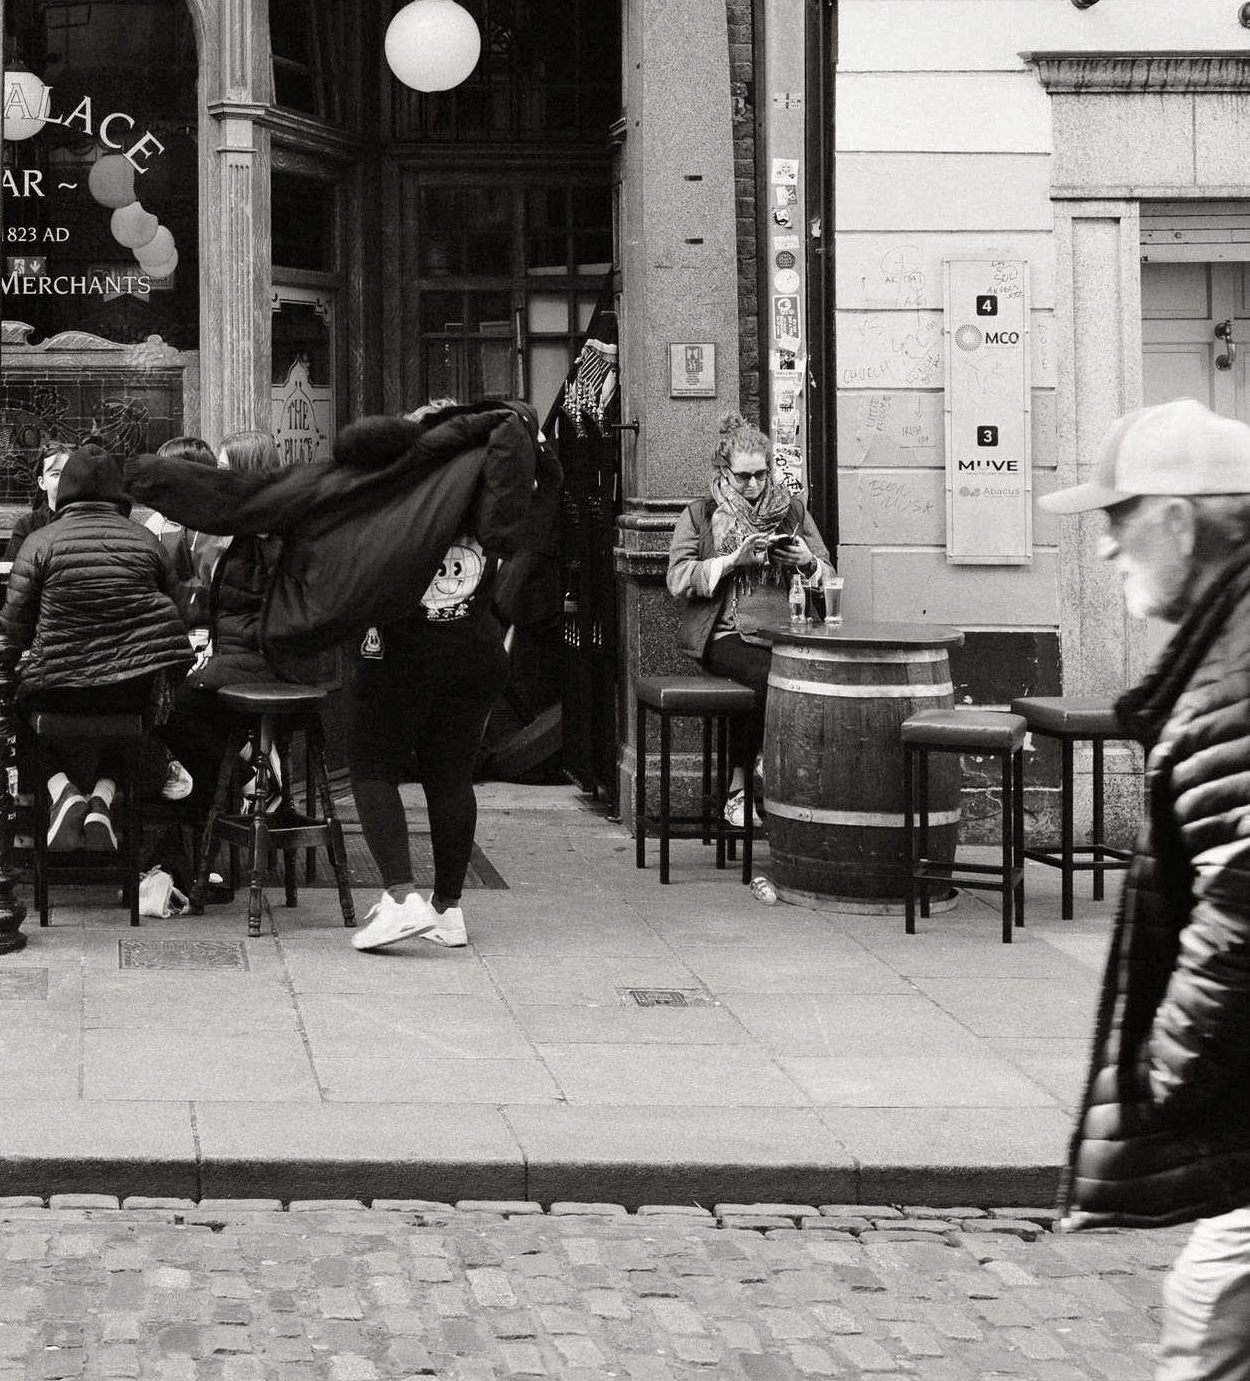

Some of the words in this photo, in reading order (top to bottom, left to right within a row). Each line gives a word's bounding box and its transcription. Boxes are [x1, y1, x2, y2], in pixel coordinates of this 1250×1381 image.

[3, 82, 166, 175] ALACE
[0, 169, 46, 198] AR
[43, 227, 70, 243] AD
[0, 270, 151, 297] MERCHANTS
[288, 398, 310, 431] THE
[983, 487, 1020, 496] Abacus
